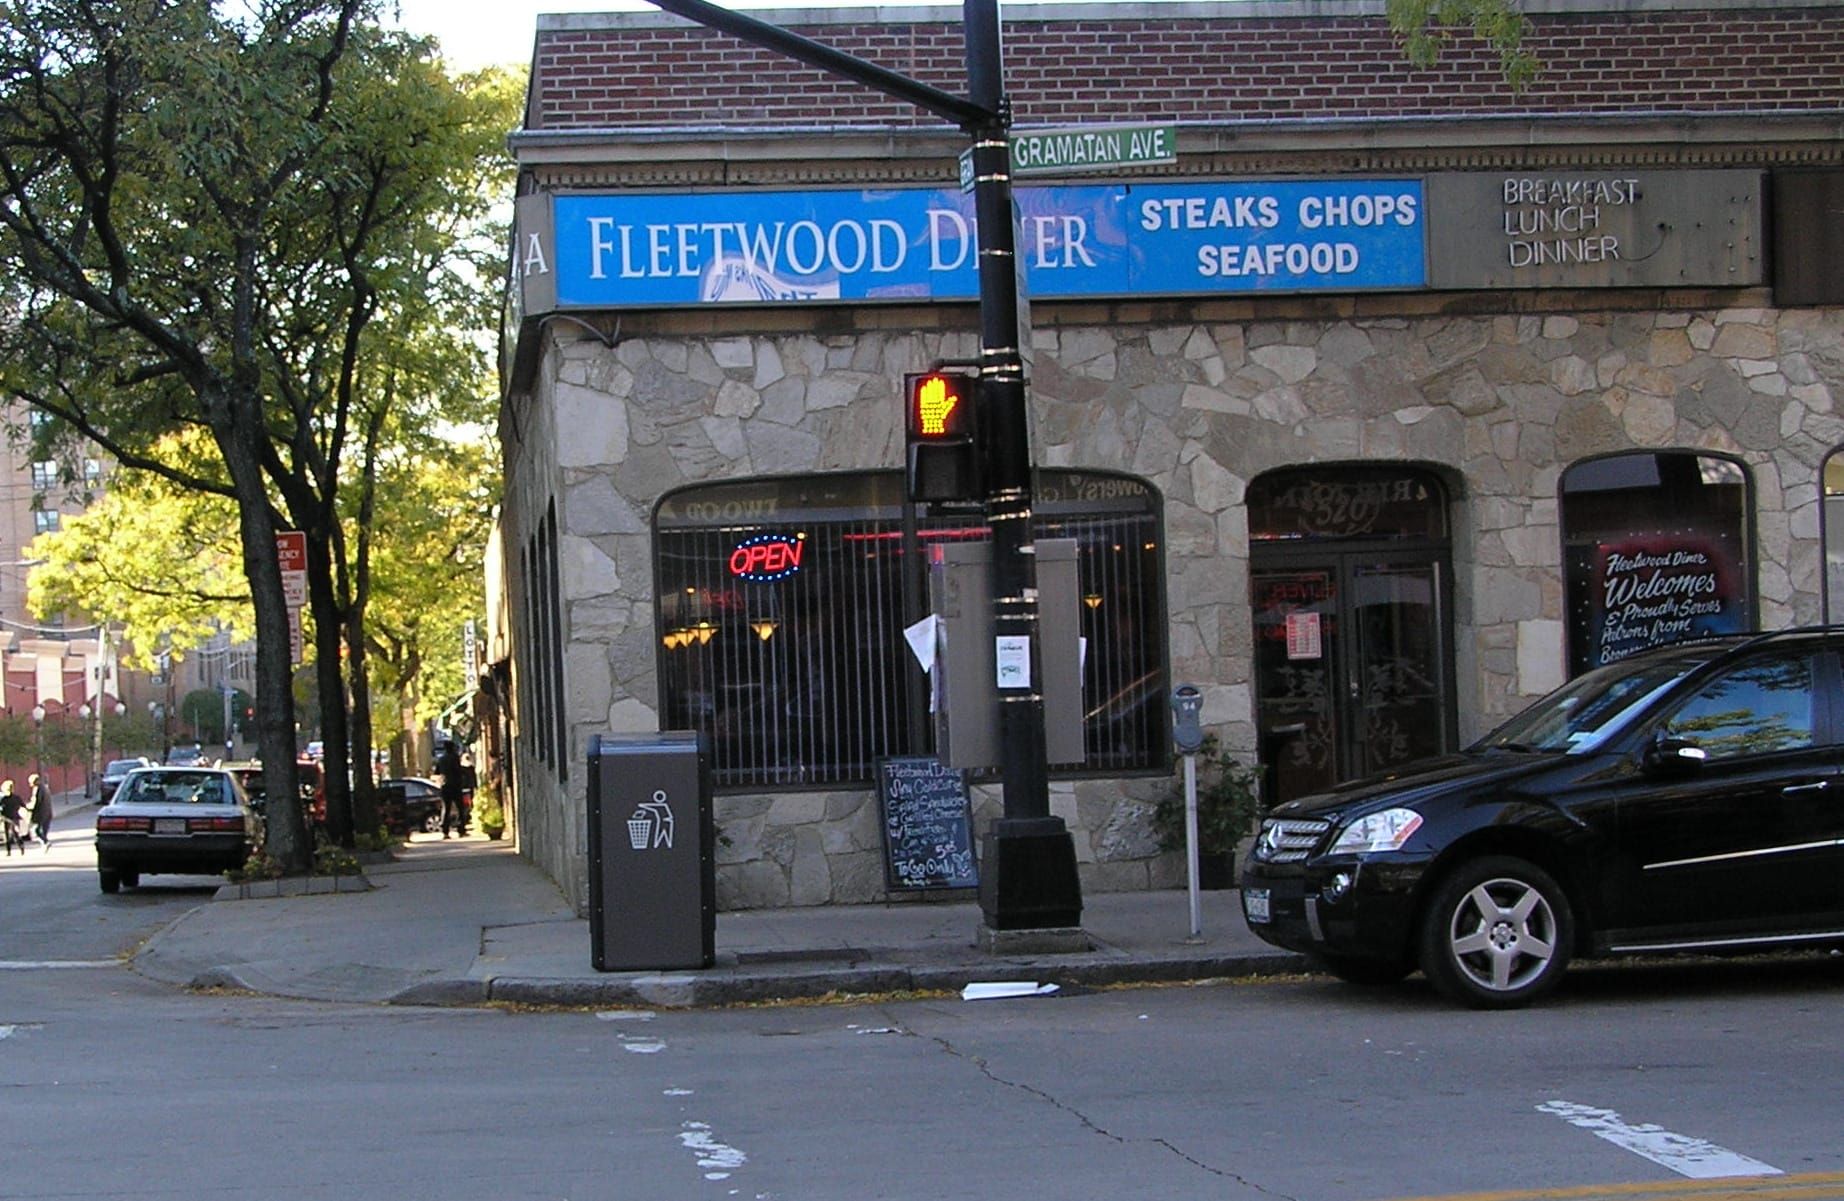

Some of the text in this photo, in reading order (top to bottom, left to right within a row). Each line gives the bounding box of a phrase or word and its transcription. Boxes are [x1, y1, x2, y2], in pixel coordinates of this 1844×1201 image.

[1014, 129, 1173, 166] GRAMATAN AVE.
[1504, 178, 1639, 205] BREAKFAST
[1140, 193, 1418, 231] STEAKS CHOPS
[1505, 205, 1600, 235] LUNCH
[586, 208, 1097, 280] FLEETWOOD DER
[1198, 242, 1360, 277] SEAFOOD
[1509, 235, 1620, 267] DINNER
[730, 540, 803, 575] OPEN
[1606, 551, 1707, 576] Fleetwood Diner
[1603, 569, 1716, 609] Welcomes
[1622, 597, 1679, 622] Proudly
[1678, 599, 1721, 617] Serves
[1650, 618, 1691, 641] from
[465, 624, 476, 683] LOTTO
